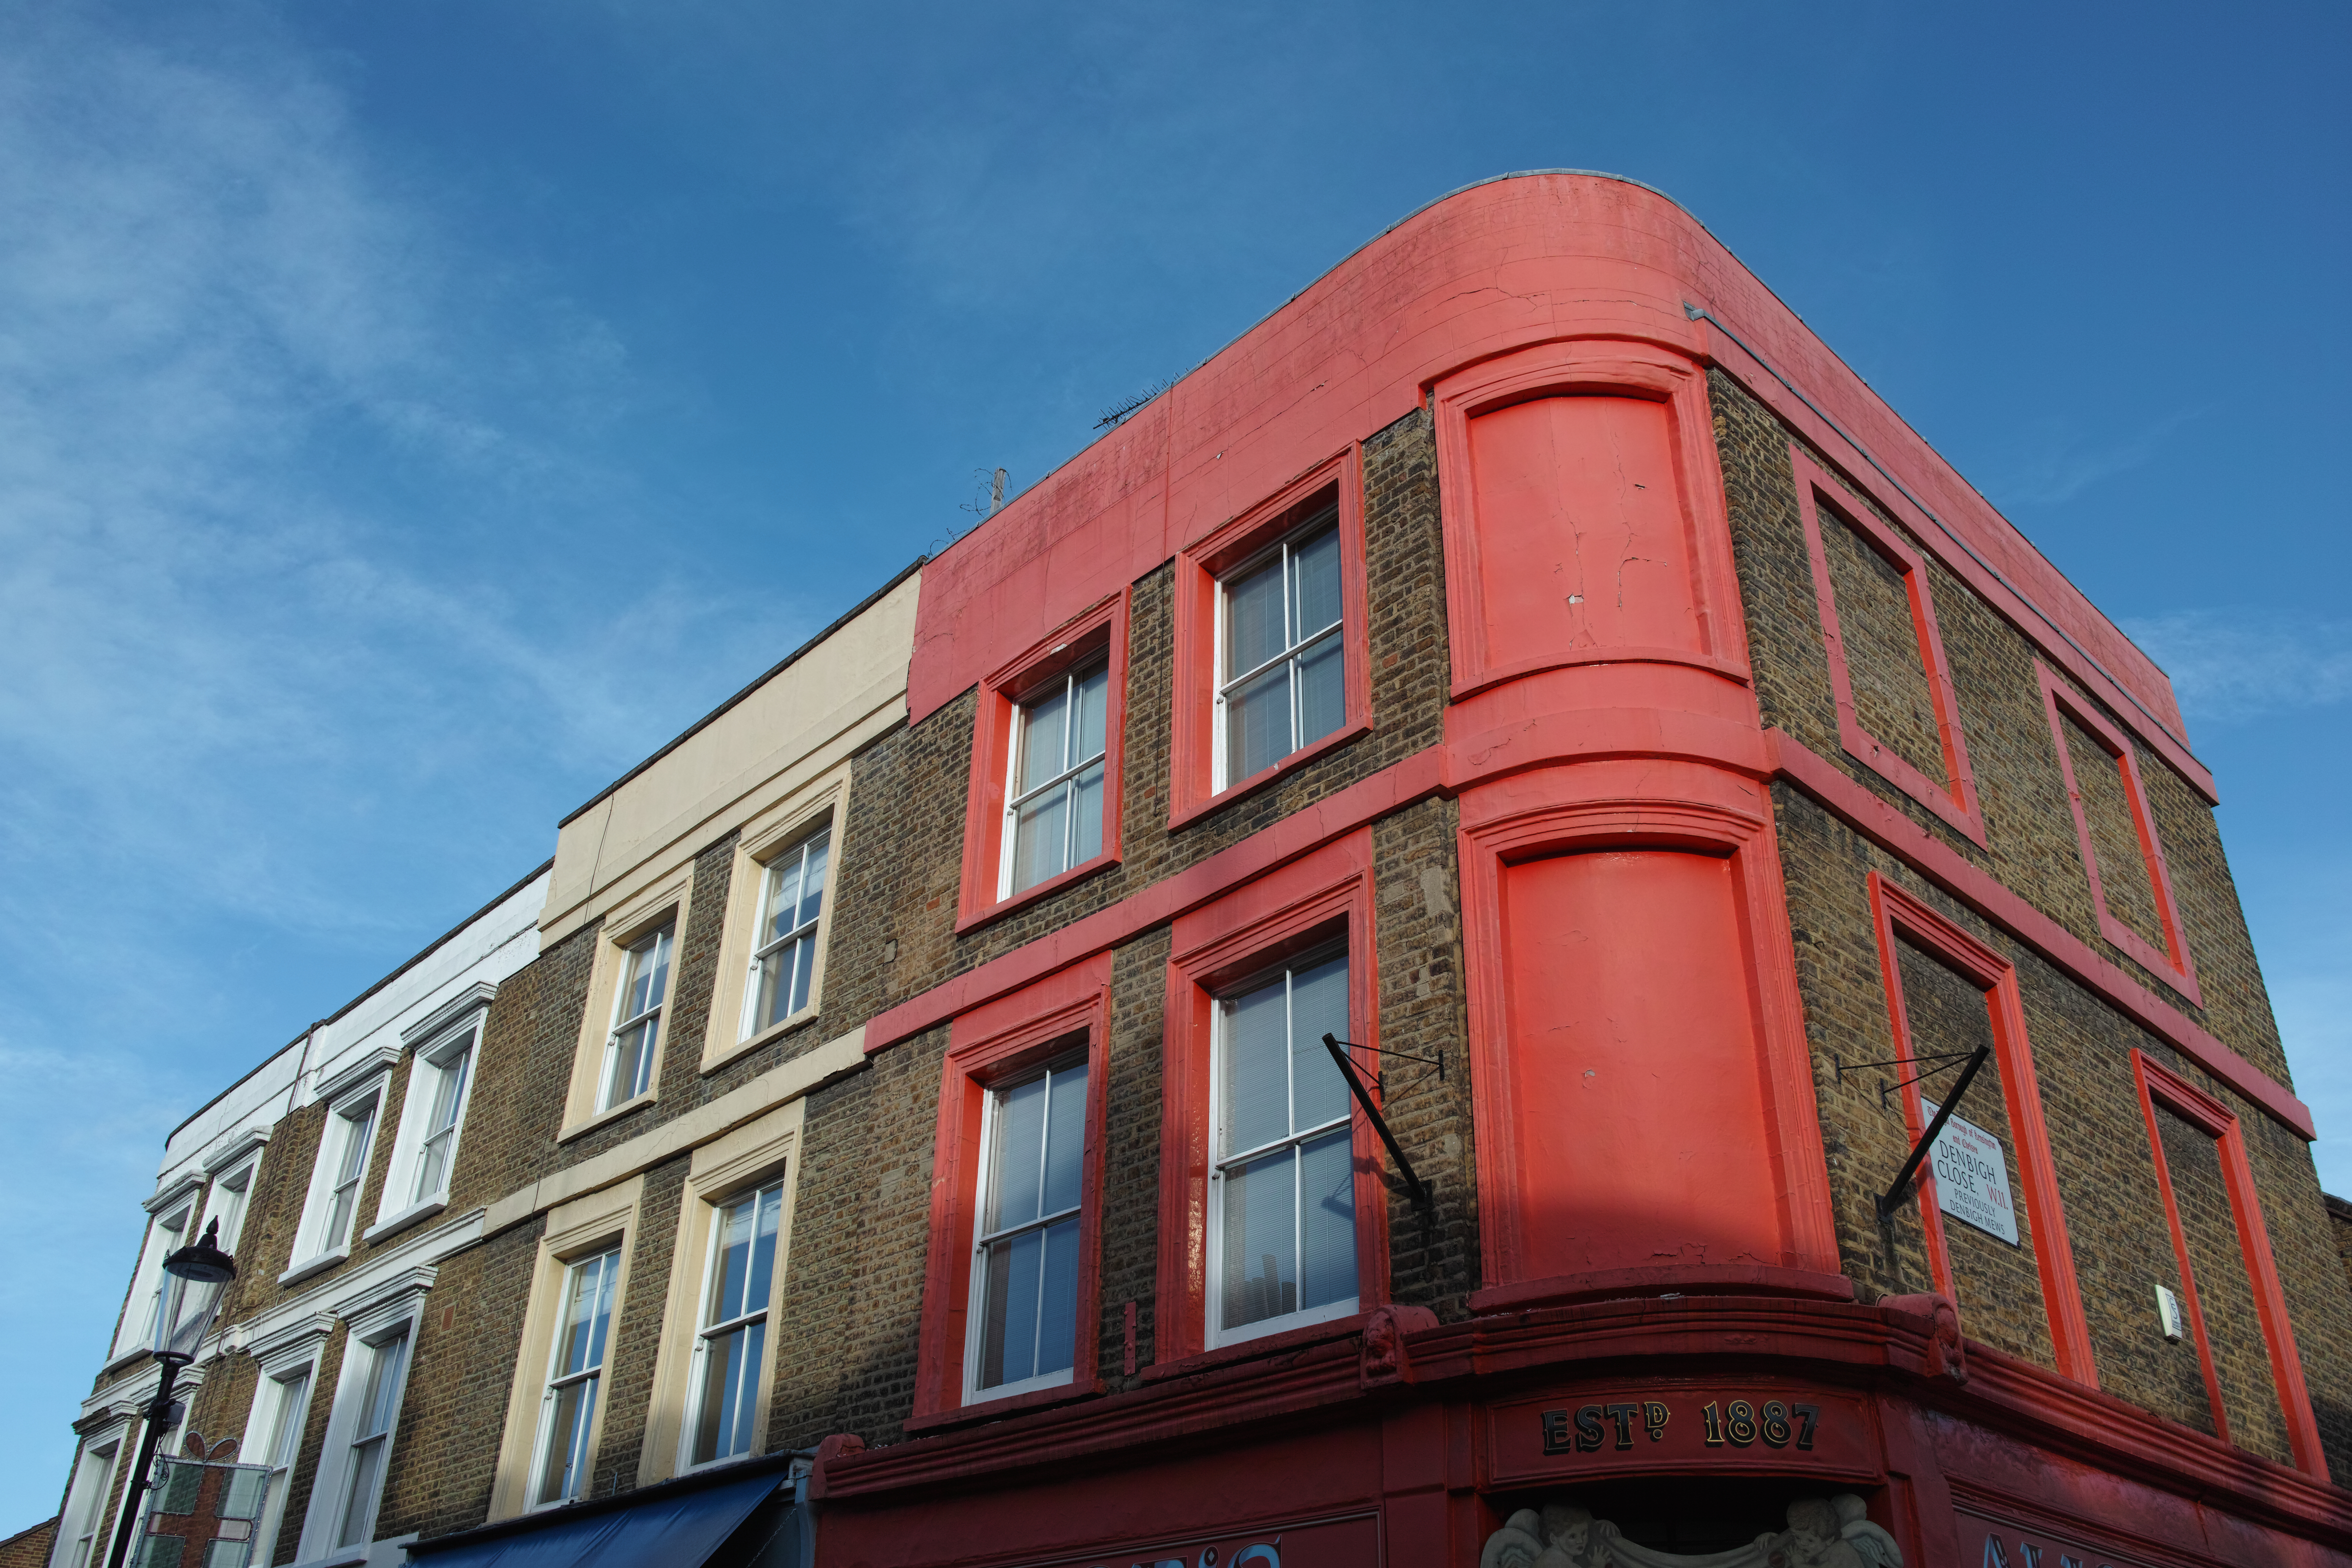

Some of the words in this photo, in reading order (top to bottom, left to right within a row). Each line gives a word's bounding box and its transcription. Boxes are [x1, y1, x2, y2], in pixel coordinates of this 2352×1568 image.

[1927, 1106, 1936, 1117] The
[1950, 1118, 1968, 1136] Borough
[1968, 1128, 1973, 1138] of
[1939, 1140, 1996, 1185] DENBIGH
[1952, 1135, 1960, 1145] and
[1962, 1138, 1978, 1154] Chelsea
[1938, 1160, 1979, 1196] CLOSE,
[1950, 1199, 1984, 1224] DENBIGH
[1984, 1216, 2005, 1235] MEWS
[1954, 1188, 1996, 1218] PREVIOUSLY
[1700, 1400, 1820, 1451] 1887
